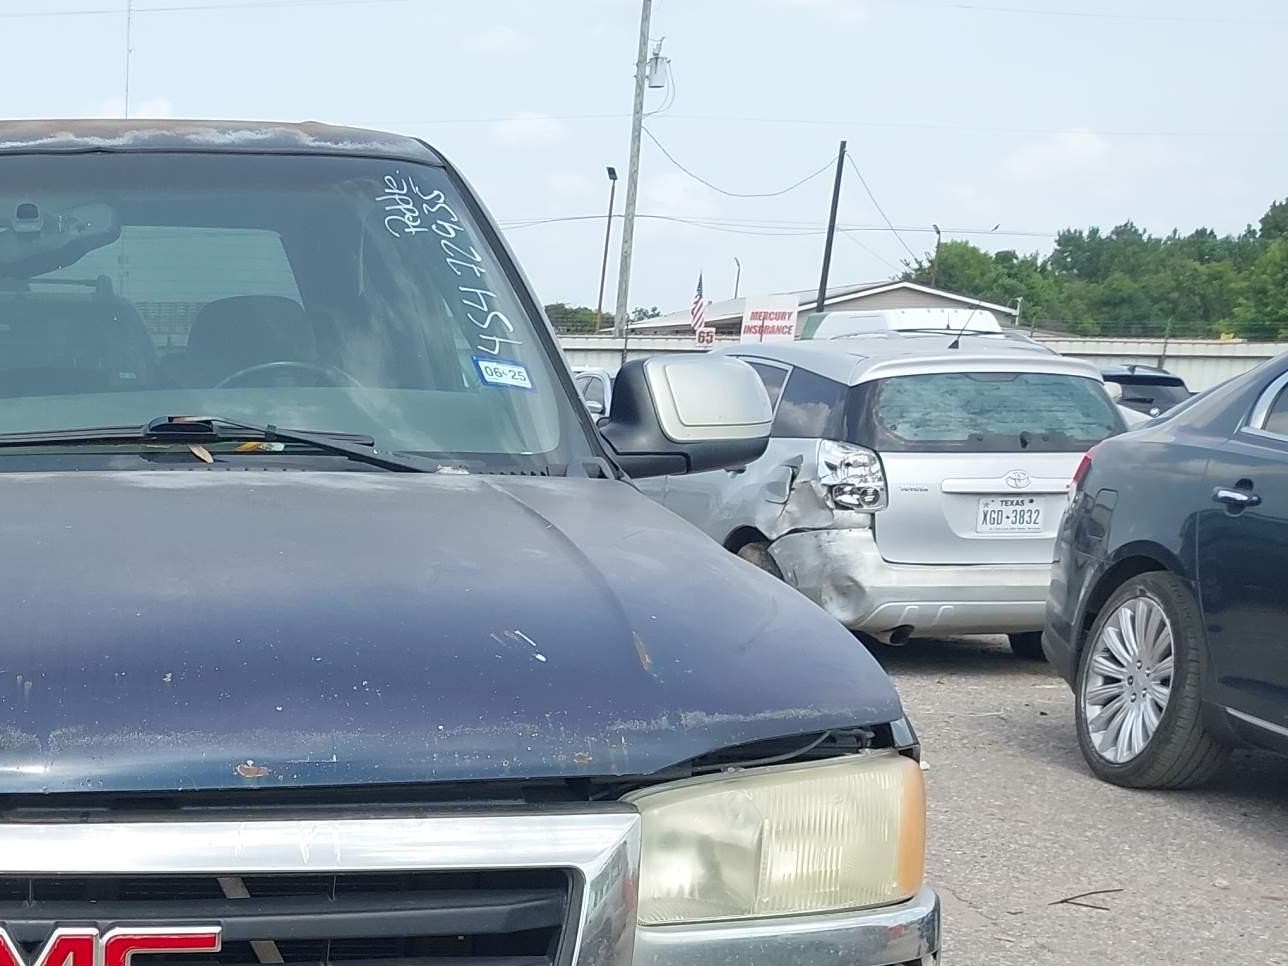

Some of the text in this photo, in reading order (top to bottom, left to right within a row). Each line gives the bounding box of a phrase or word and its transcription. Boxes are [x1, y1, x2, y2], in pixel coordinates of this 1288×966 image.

[750, 311, 793, 321] MERCURY
[697, 331, 713, 344] 65
[1000, 499, 1025, 507] TEXAS
